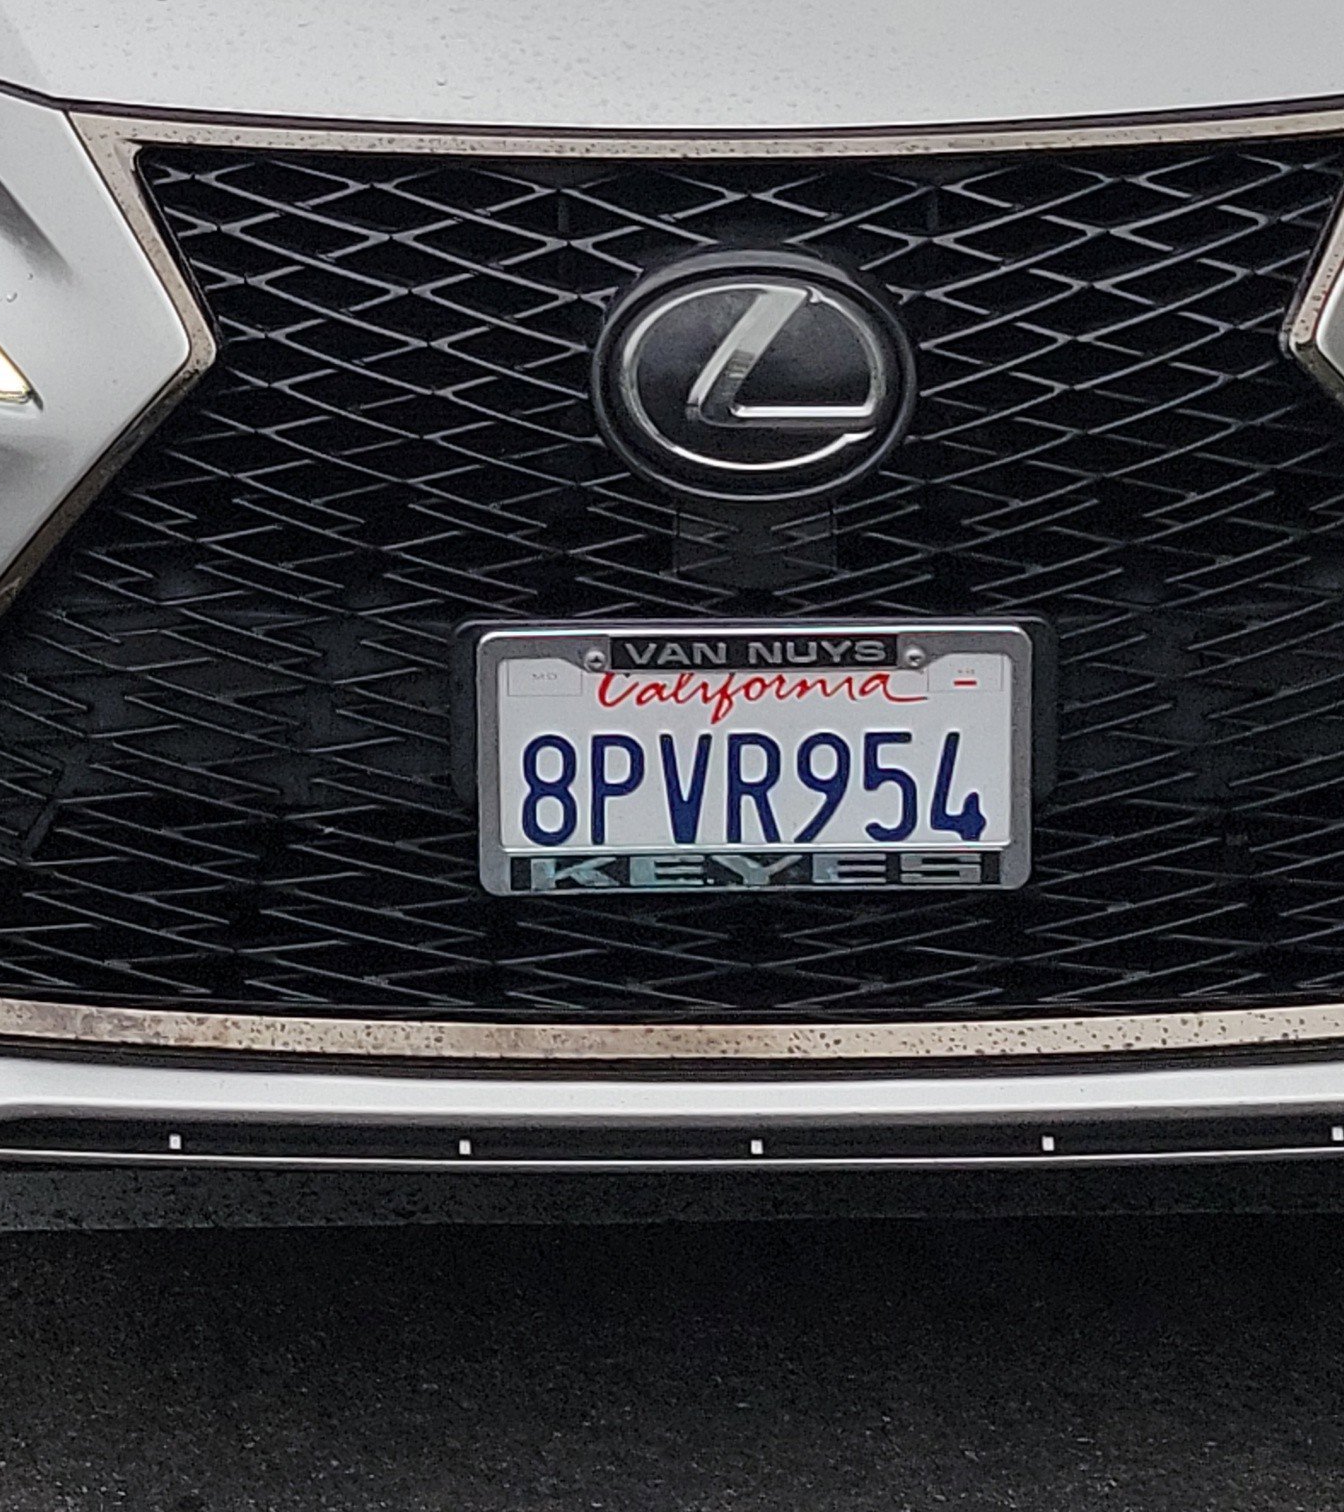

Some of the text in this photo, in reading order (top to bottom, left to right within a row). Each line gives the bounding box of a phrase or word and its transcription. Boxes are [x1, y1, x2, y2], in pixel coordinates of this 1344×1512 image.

[625, 640, 888, 665] VAN NUYS
[596, 670, 929, 725] California
[521, 731, 988, 846] 8PVR954
[530, 854, 982, 891] KEYES
